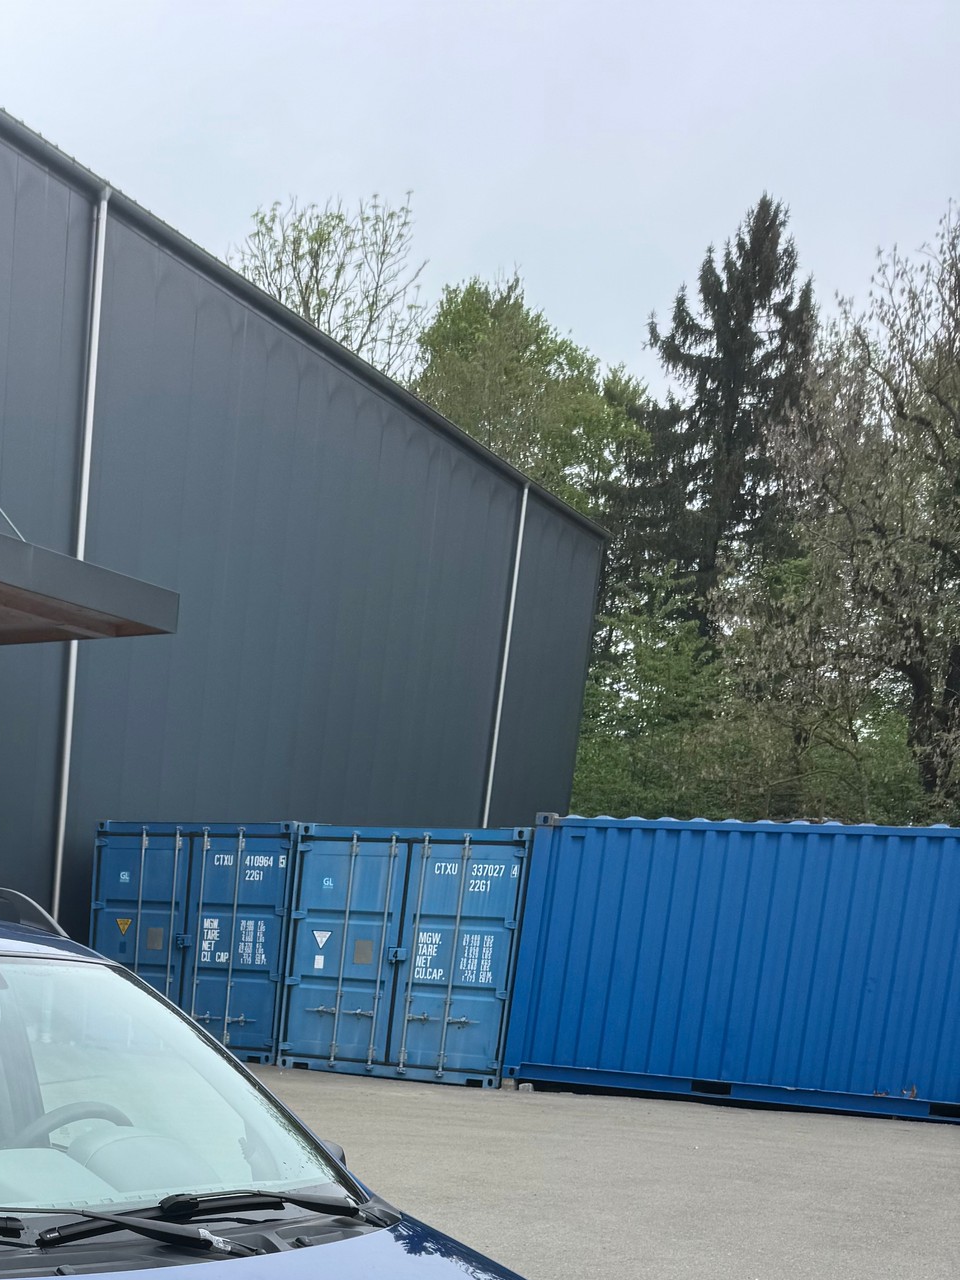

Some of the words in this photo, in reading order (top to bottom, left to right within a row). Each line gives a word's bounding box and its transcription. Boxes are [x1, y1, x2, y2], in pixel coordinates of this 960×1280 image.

[214, 854, 234, 866] CTXU
[245, 855, 273, 867] 410964
[120, 871, 129, 880] GL
[245, 869, 263, 881] 22G1
[434, 862, 458, 875] CTXU
[471, 864, 505, 877] 337027
[511, 865, 519, 877] 4
[323, 877, 334, 886] GL
[469, 879, 491, 892] 22G1
[203, 929, 220, 940] TARE
[418, 932, 442, 944] MGW.
[202, 940, 215, 951] NET
[418, 944, 438, 956] TARE
[415, 955, 432, 968] NET
[414, 967, 445, 980] CU.CAP.
